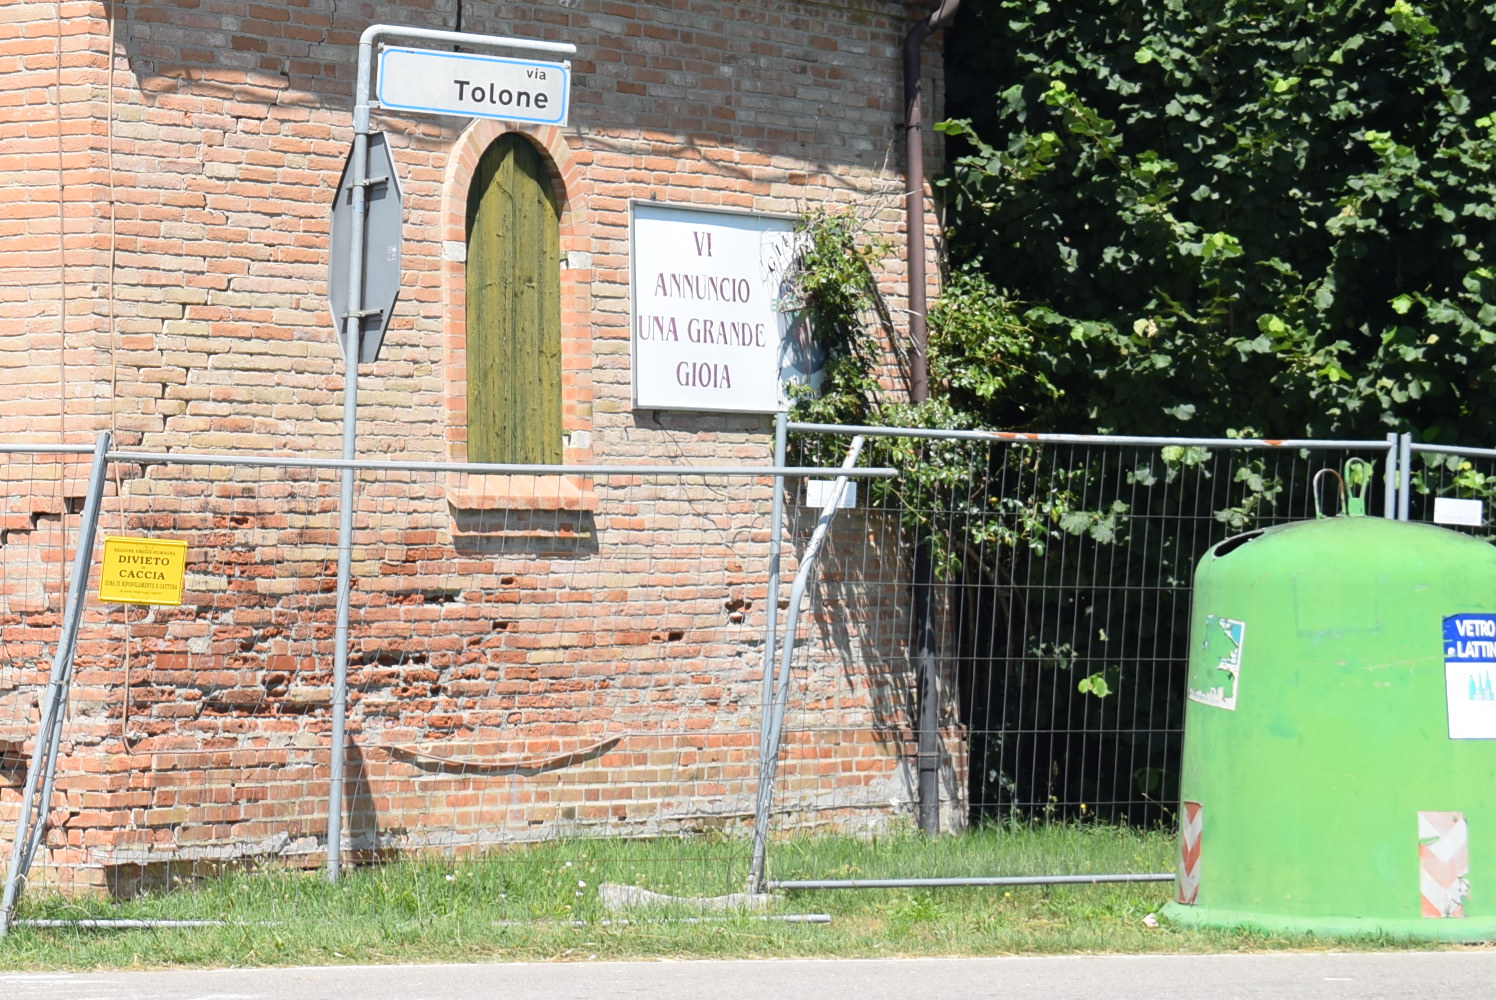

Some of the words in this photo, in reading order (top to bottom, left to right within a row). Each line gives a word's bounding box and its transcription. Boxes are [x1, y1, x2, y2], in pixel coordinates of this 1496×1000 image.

[526, 68, 547, 81] via
[453, 79, 549, 109] Tolone
[692, 231, 713, 258] VI
[654, 272, 750, 304] ANNUNCIO
[638, 315, 679, 342] UNA
[687, 318, 766, 348] GRANDE
[675, 361, 732, 389] GIOIA
[118, 555, 170, 566] DIVIETO
[119, 569, 166, 580] CACCIA
[1455, 619, 1496, 637] VETRO
[1447, 646, 1456, 656] e
